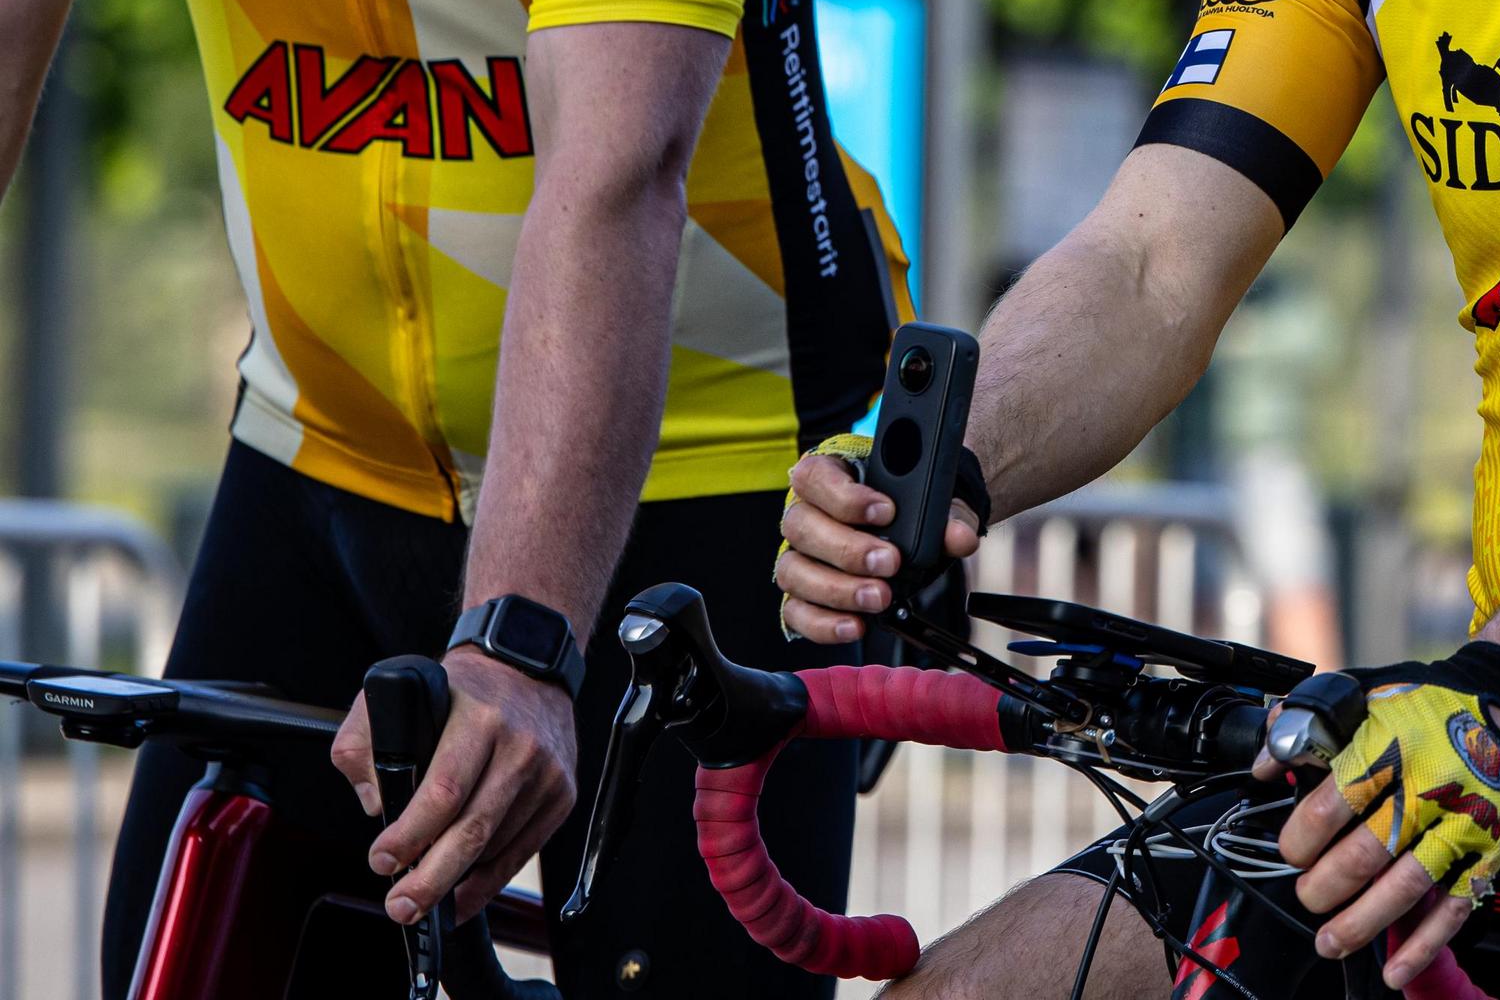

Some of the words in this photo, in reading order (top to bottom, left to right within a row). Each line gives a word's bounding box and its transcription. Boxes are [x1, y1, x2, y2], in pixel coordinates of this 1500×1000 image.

[223, 40, 535, 161] AVAN
[780, 22, 838, 280] Reittimestarit
[44, 692, 94, 709] GARMIN
